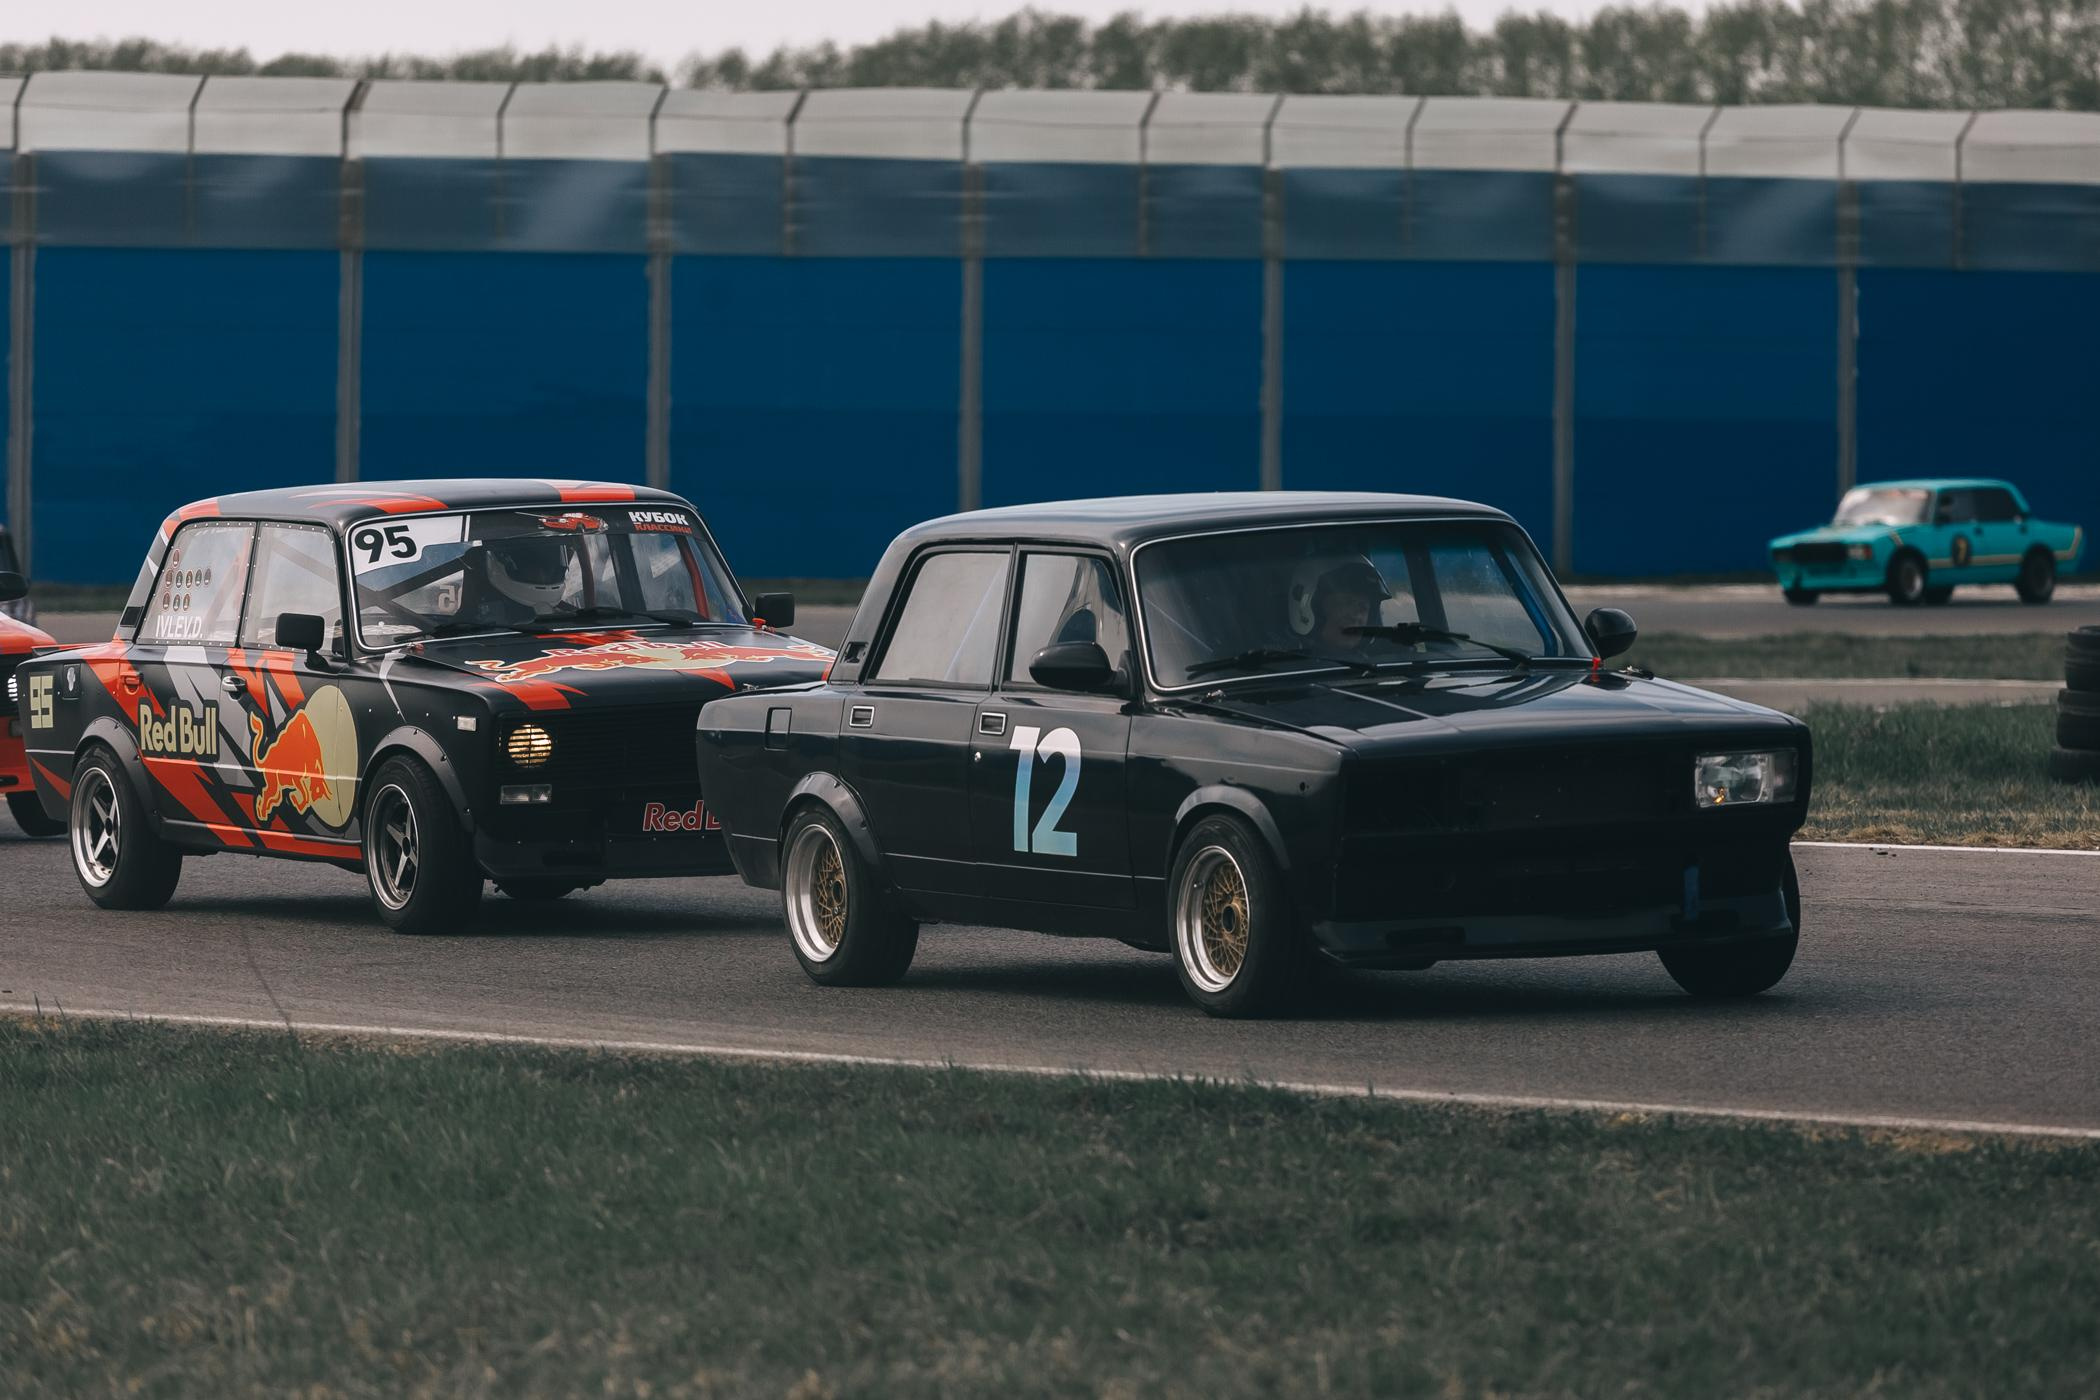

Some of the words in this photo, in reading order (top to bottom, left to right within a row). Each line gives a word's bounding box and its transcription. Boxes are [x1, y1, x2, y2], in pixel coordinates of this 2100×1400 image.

[628, 511, 689, 526] КУБОК
[355, 525, 417, 564] 95
[30, 675, 55, 729] 95
[140, 704, 177, 752] Red
[179, 707, 217, 755] Bull
[1010, 726, 1081, 857] 12
[642, 799, 704, 831] Red
